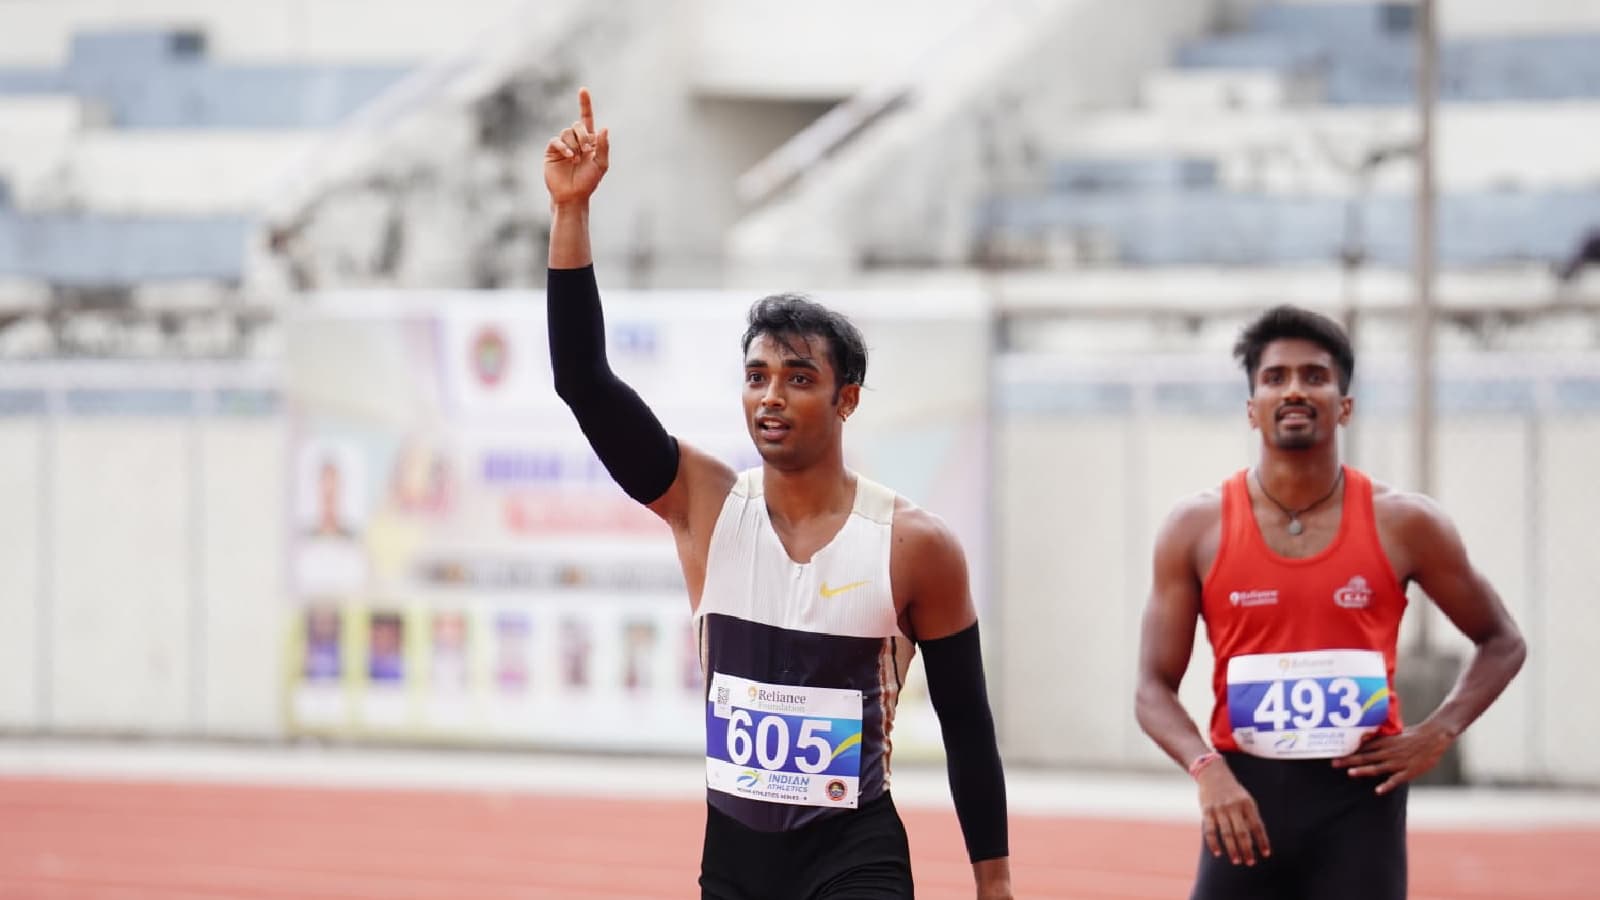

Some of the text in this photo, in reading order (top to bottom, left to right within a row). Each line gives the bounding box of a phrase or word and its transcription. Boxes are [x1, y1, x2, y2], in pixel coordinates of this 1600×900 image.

[758, 689, 806, 705] Reliance
[1254, 678, 1362, 730] 493
[728, 710, 832, 774] 605
[769, 774, 810, 786] INDIAN
[767, 784, 808, 793] ATHLETICS
